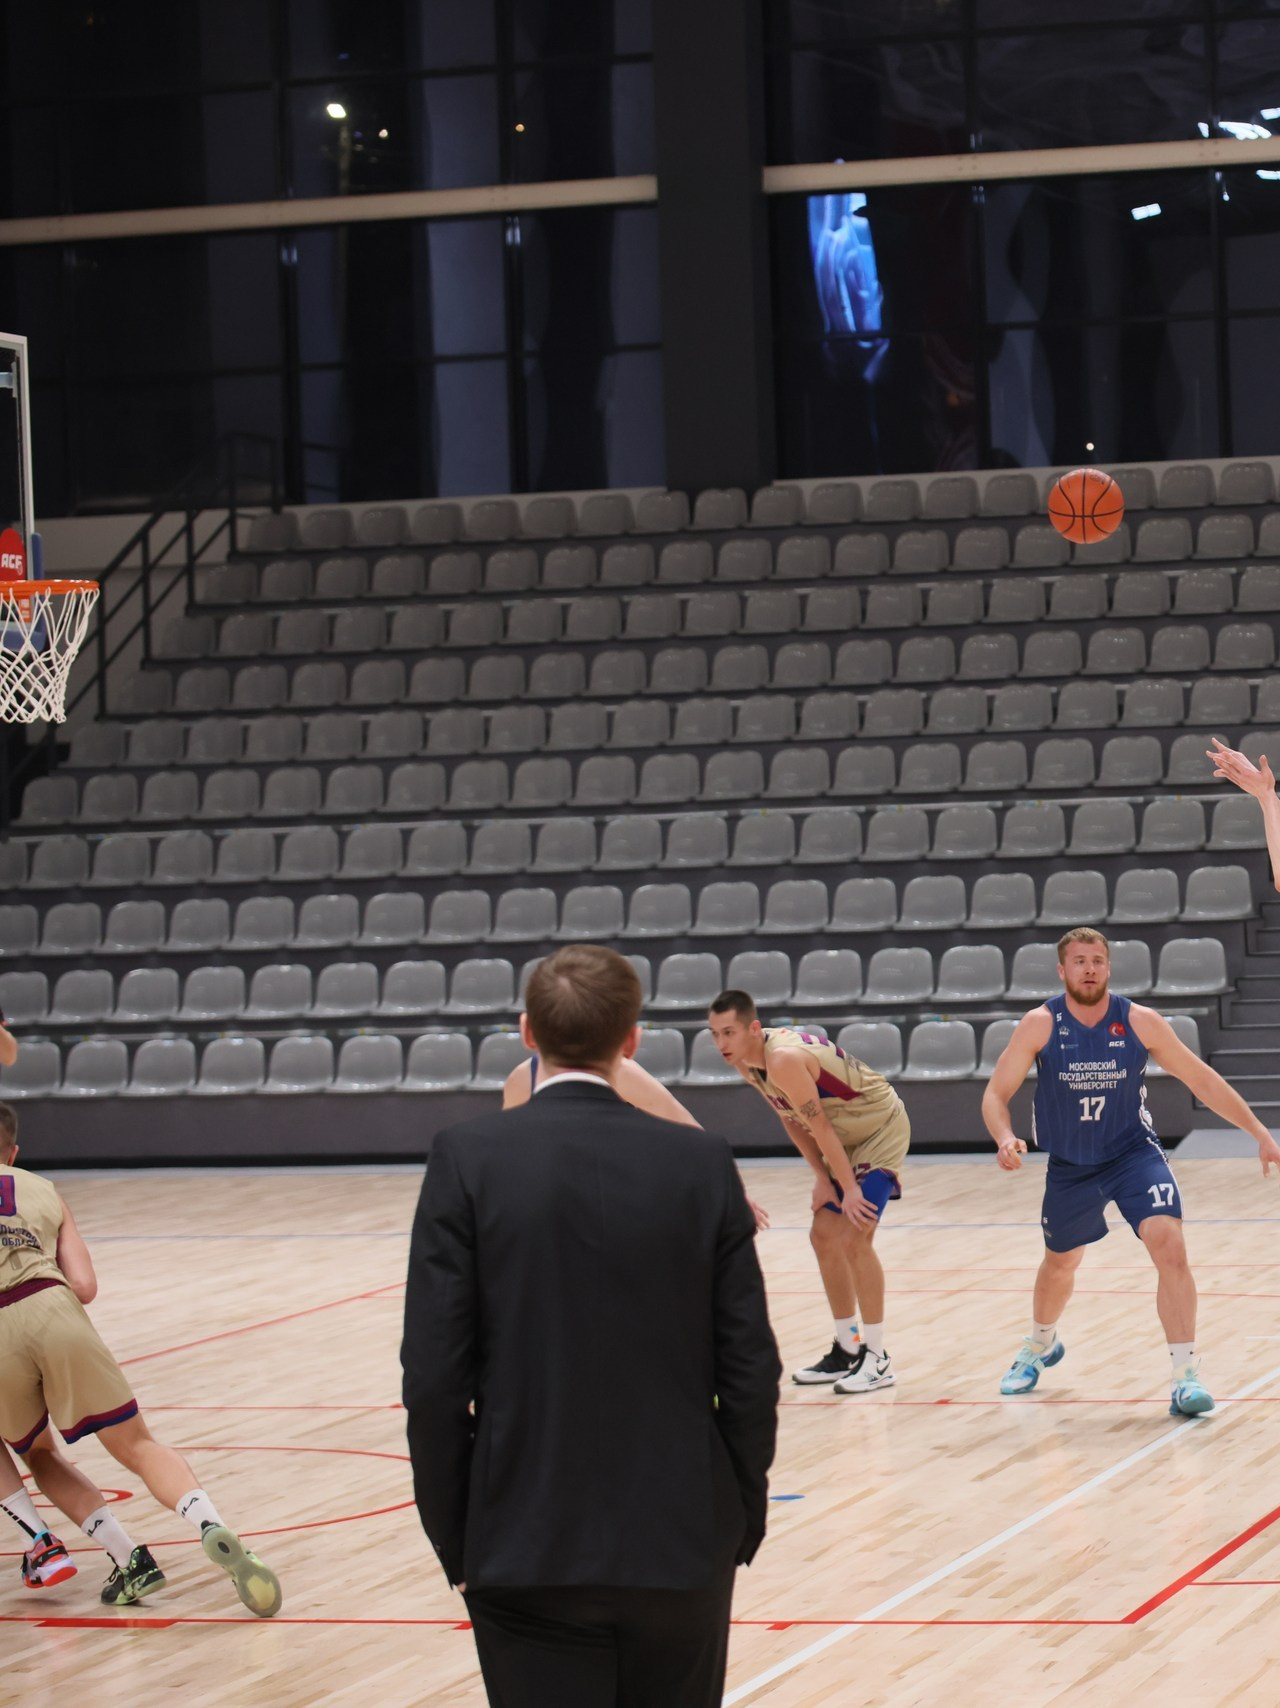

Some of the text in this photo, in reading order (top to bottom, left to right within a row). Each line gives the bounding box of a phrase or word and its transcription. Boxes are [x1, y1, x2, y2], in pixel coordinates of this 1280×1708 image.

[1068, 1059, 1117, 1072] МОСКОВСКИЙ
[1058, 1069, 1128, 1082] ГОСУДАРСТВЕННЫЙ
[1068, 1080, 1118, 1090] УНИВЕРСИТЕТ
[1079, 1095, 1106, 1121] 17
[1147, 1183, 1175, 1208] 17
